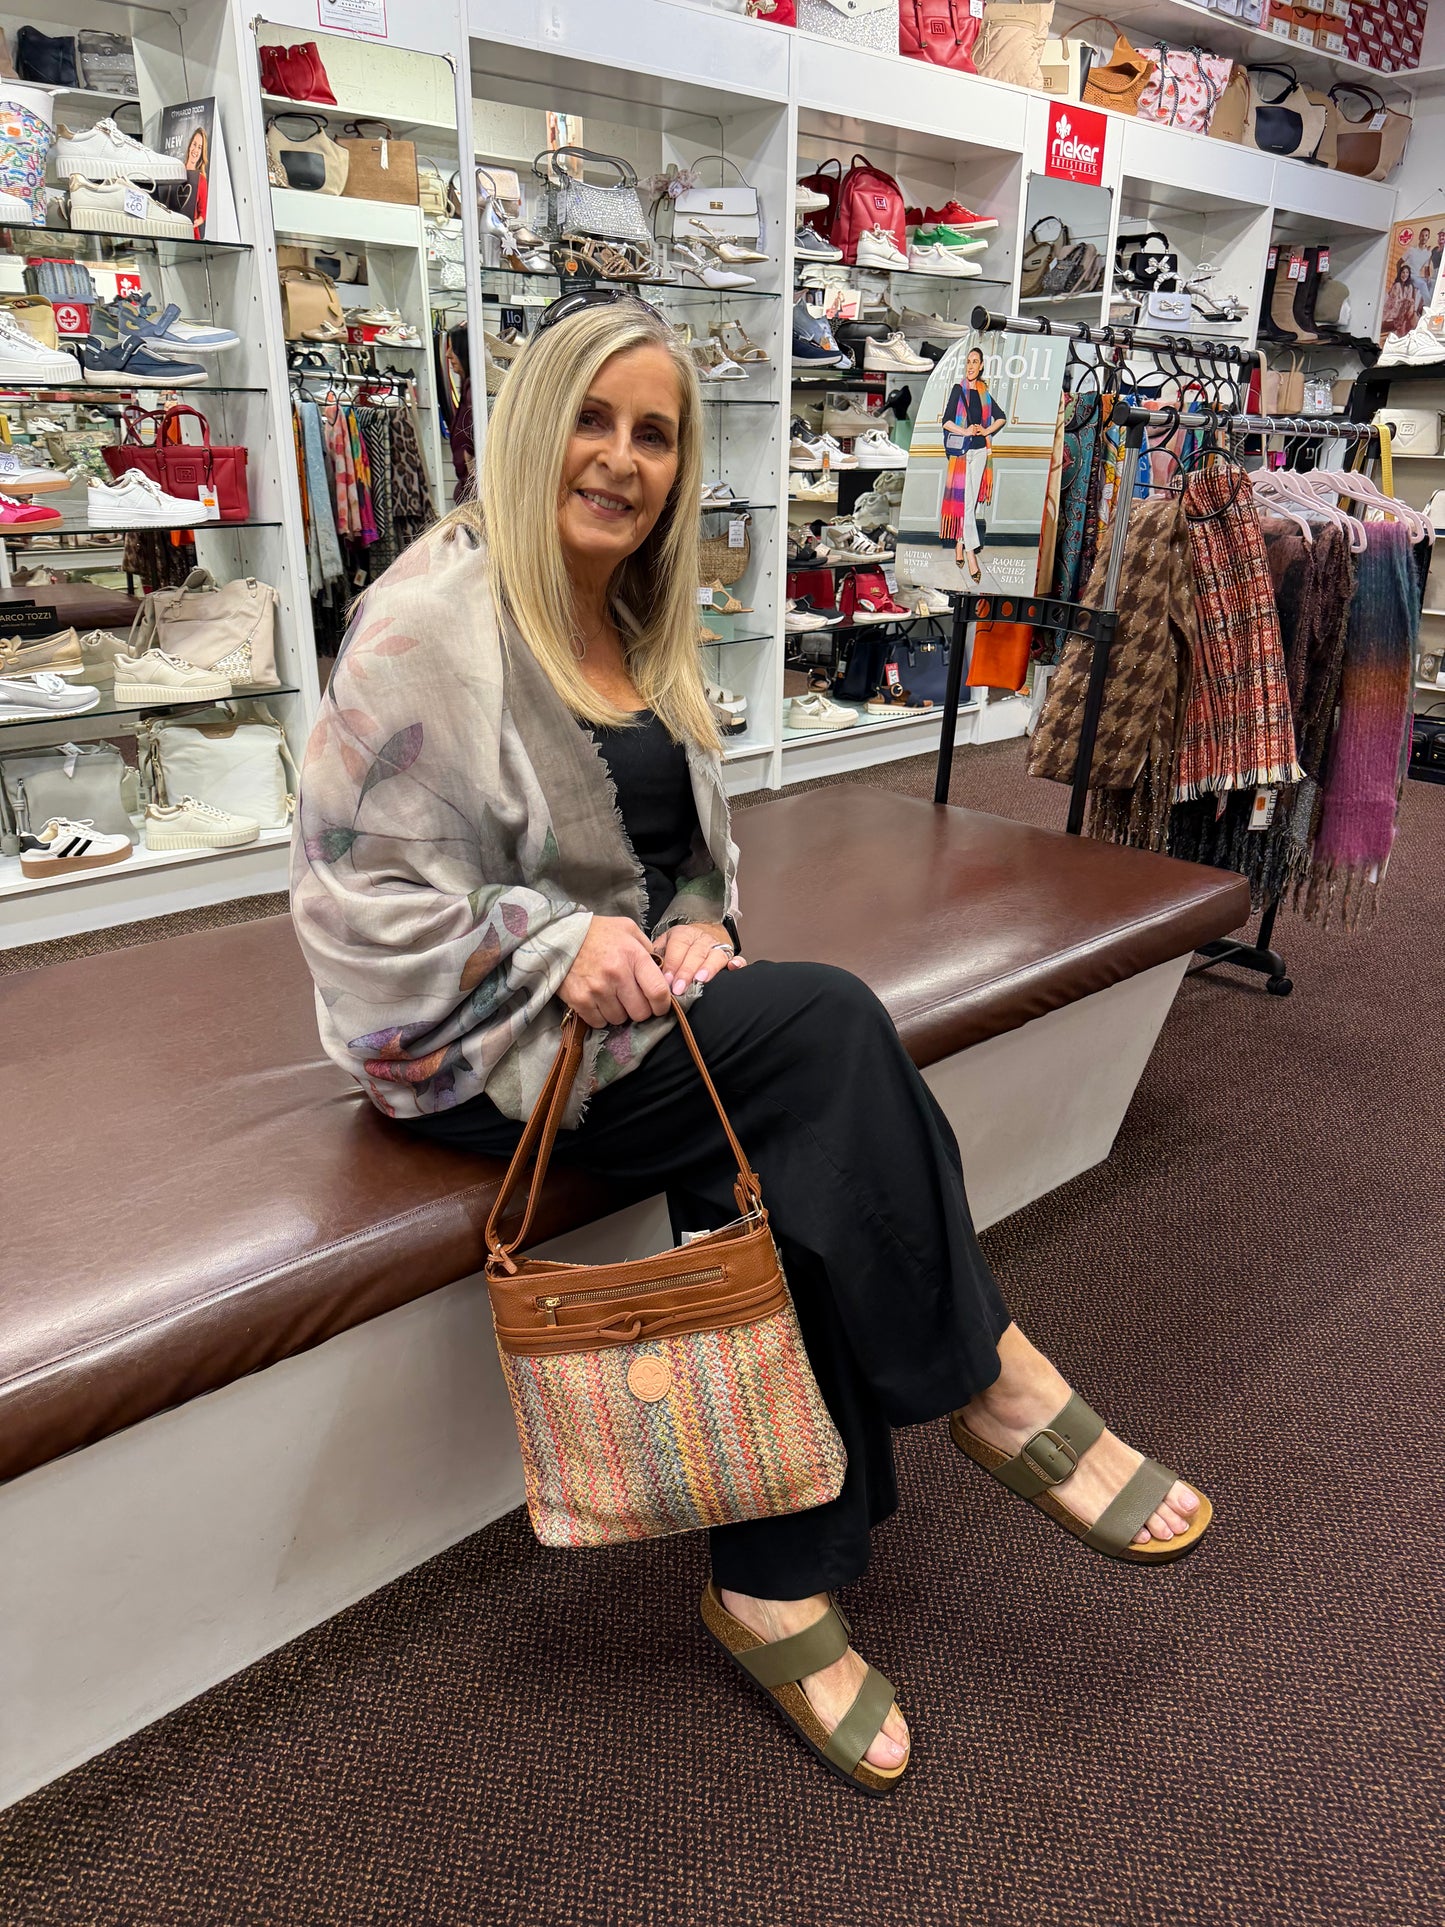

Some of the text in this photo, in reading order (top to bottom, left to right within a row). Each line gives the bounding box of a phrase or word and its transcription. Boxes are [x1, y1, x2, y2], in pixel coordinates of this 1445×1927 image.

[165, 134, 183, 150] NEW
[1052, 135, 1099, 163] rieker
[982, 347, 1053, 381] moll
[903, 550, 933, 559] AUTUMN
[903, 558, 929, 567] WINTER
[992, 557, 1027, 567] RAQUEL
[986, 565, 1026, 576] SÁNCHEZ
[1000, 575, 1025, 584] SILVA
[0, 611, 52, 622] ARCO TOZZI
